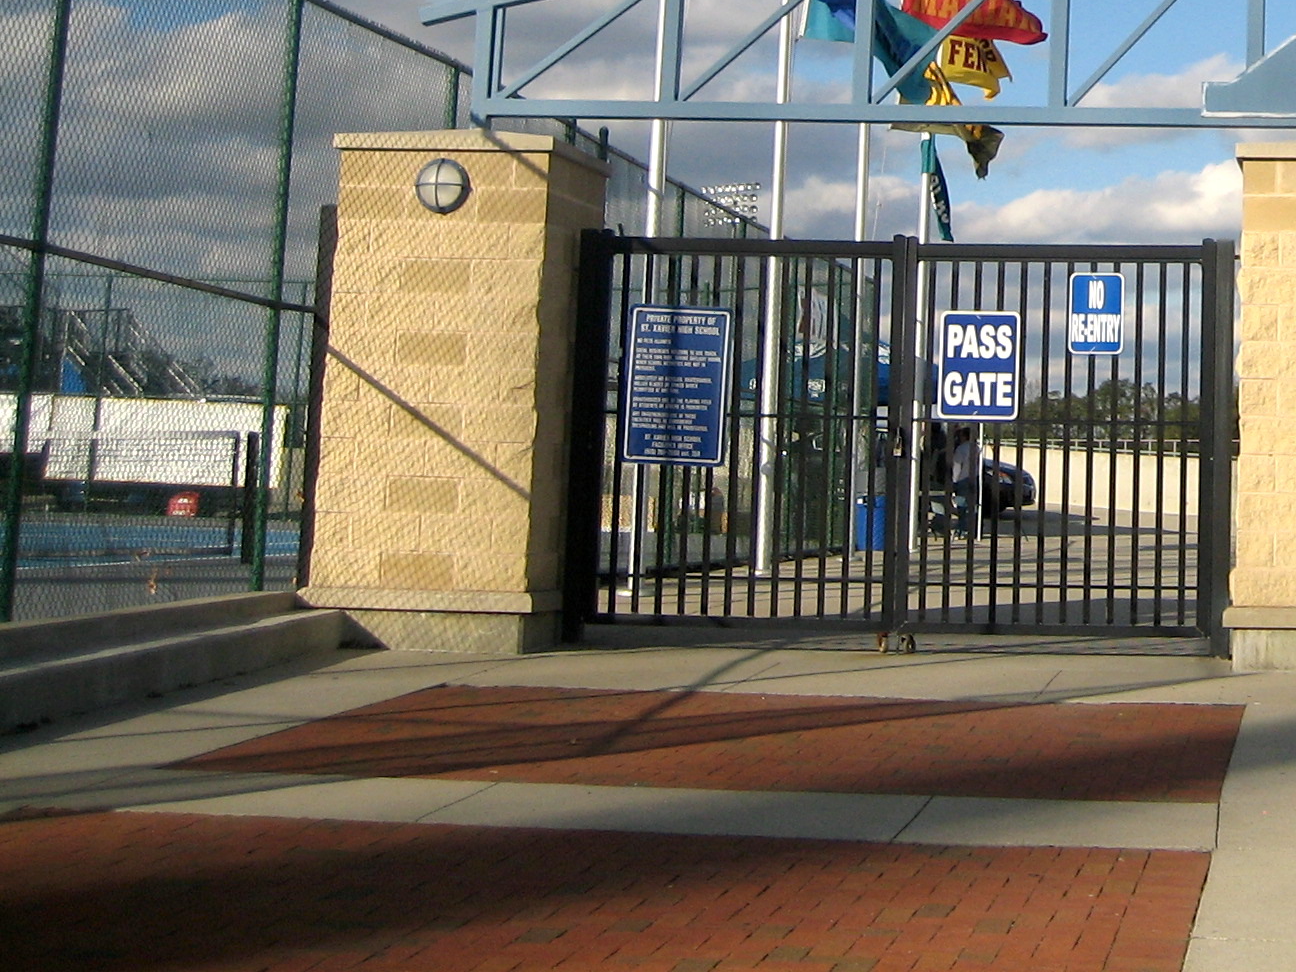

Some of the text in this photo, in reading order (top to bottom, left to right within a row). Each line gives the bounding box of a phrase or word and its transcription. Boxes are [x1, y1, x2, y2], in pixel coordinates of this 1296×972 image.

[1088, 280, 1105, 310] NO
[946, 324, 1012, 359] PASS
[1071, 313, 1121, 343] RE-ENTRY
[943, 372, 1013, 407] GATE
